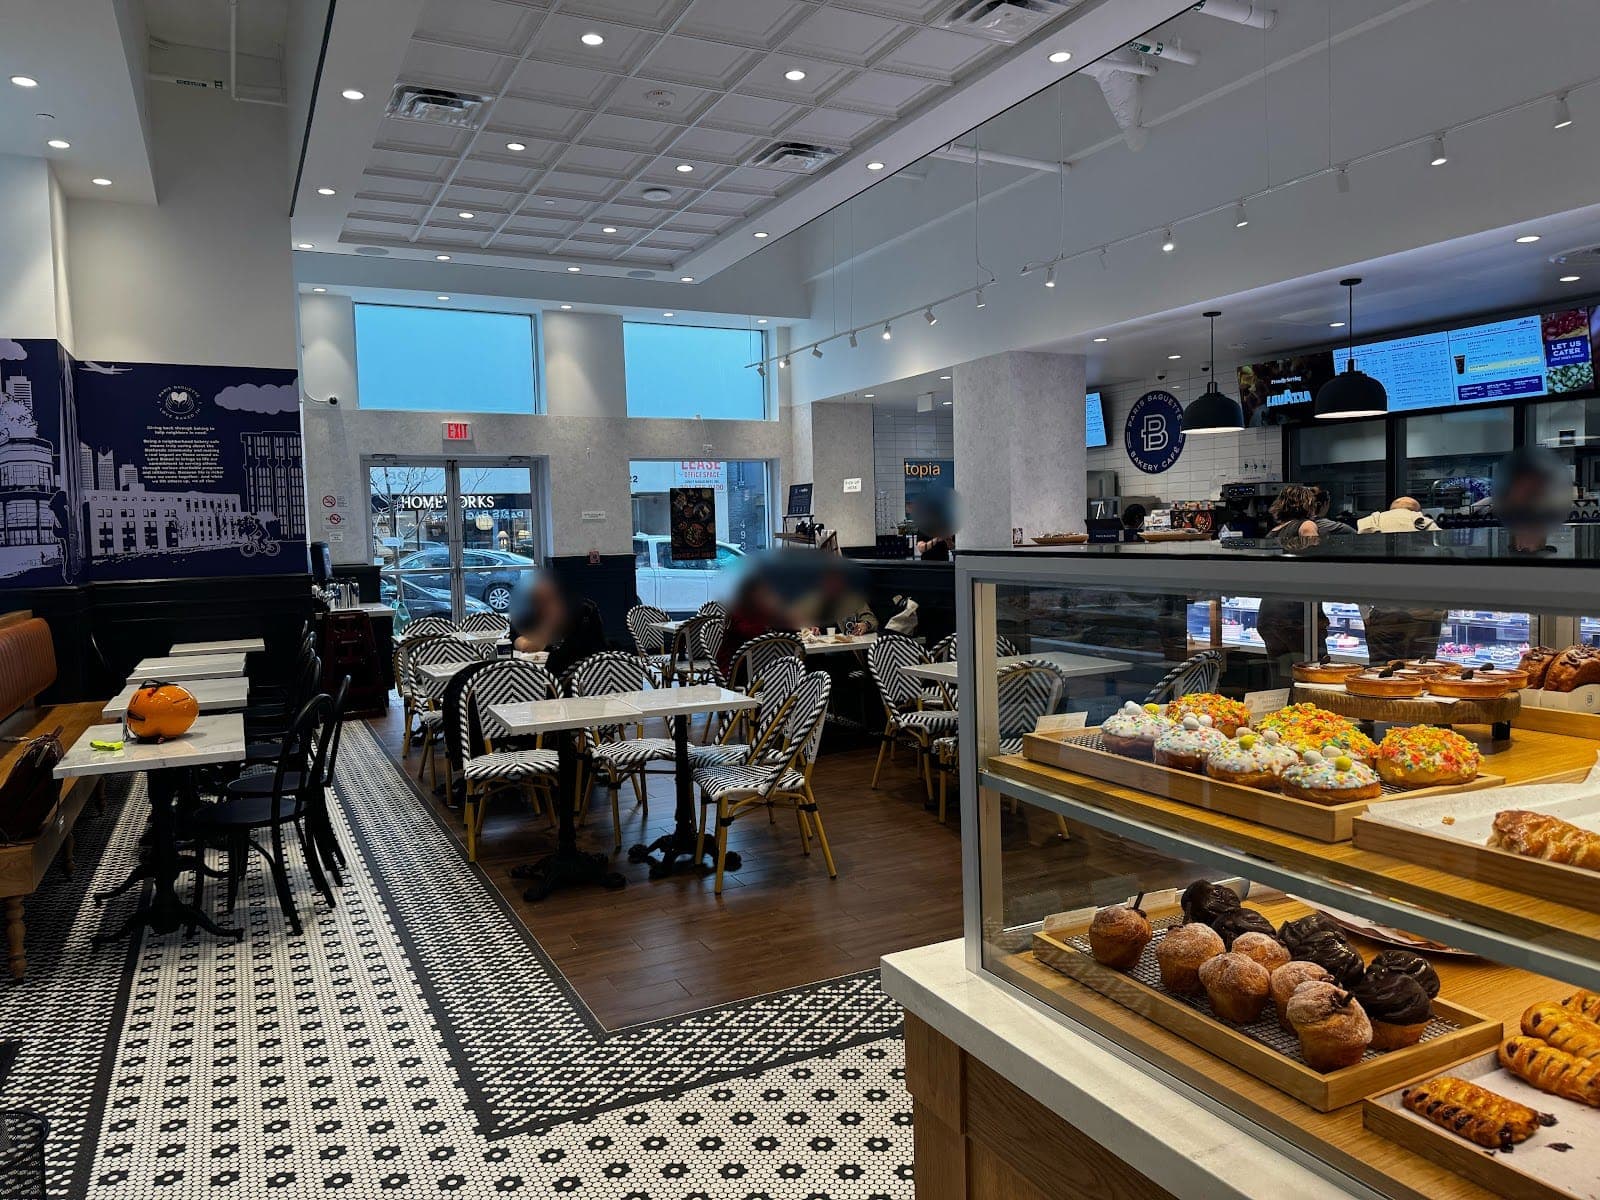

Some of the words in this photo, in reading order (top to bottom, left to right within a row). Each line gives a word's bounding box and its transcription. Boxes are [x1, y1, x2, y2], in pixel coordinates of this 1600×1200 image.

[1551, 343, 1568, 351] LET
[1570, 340, 1581, 348] US
[1553, 348, 1580, 357] CATER
[1266, 389, 1312, 408] LAVAZZA
[1128, 400, 1145, 427] PARIS
[1147, 394, 1182, 422] BAGUETTE
[447, 423, 468, 439] EXIT
[681, 460, 721, 470] LEASE
[1130, 450, 1158, 471] BAKERY
[906, 462, 940, 479] topia
